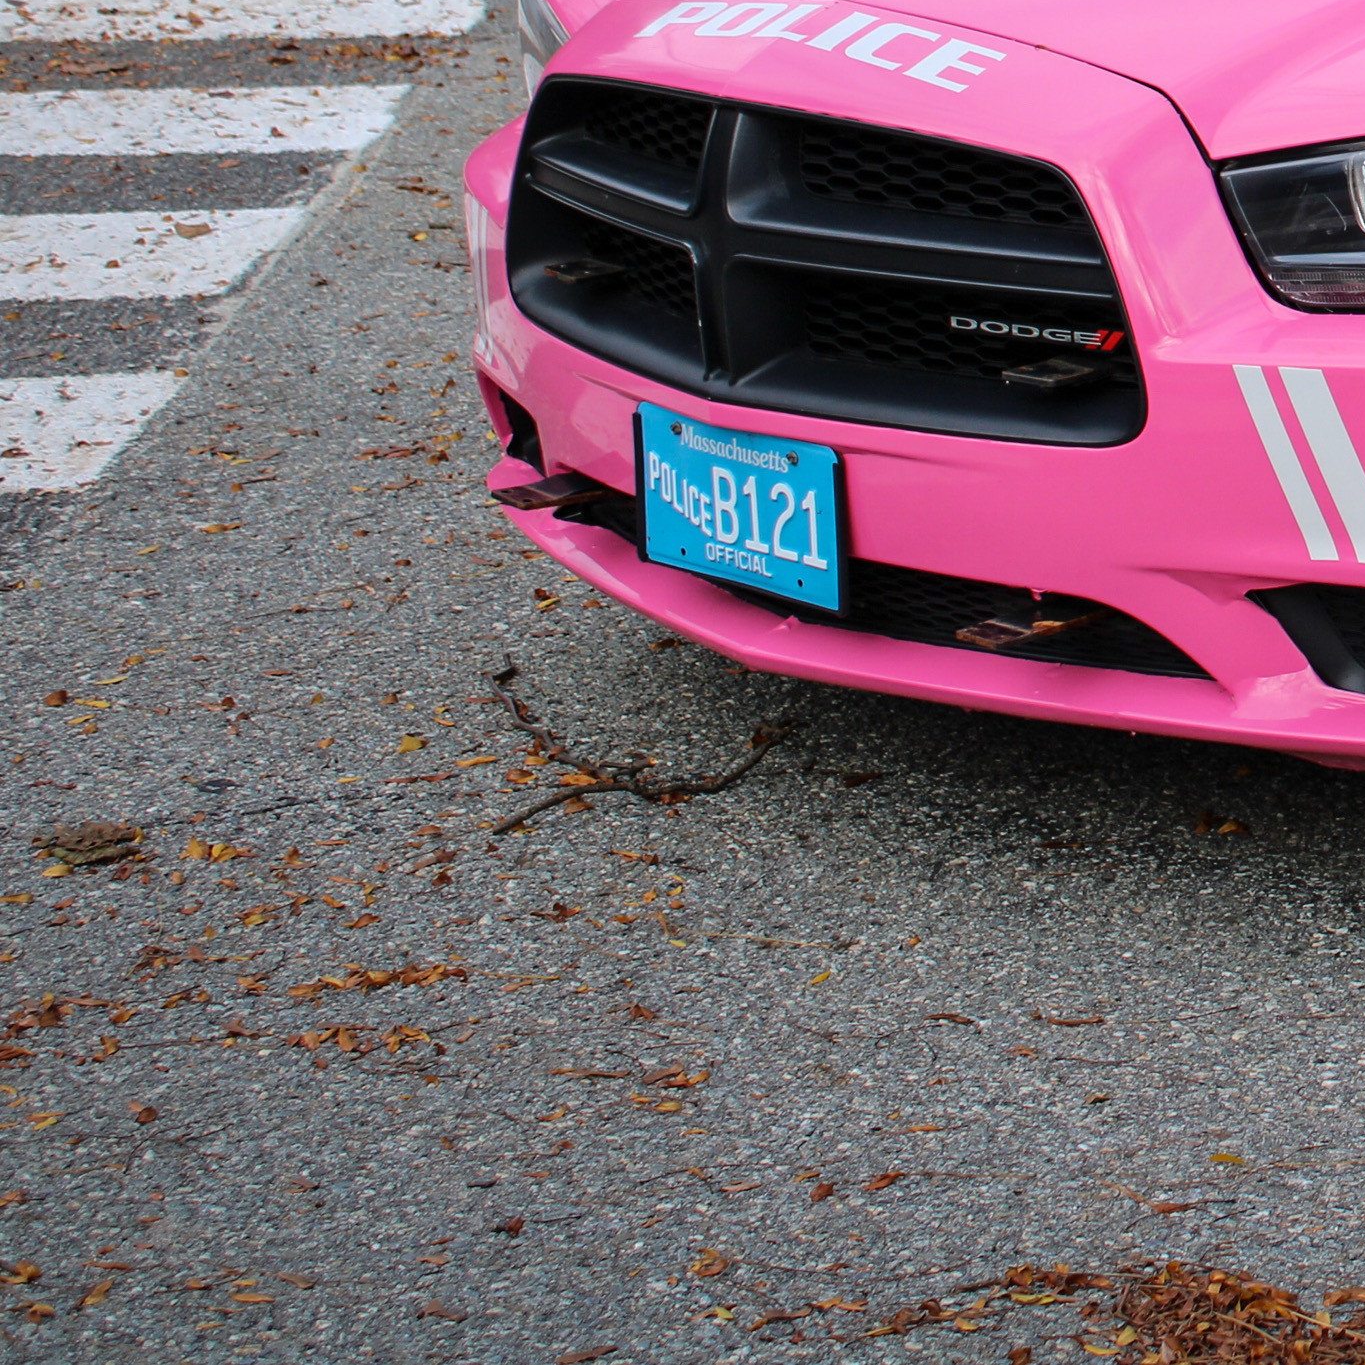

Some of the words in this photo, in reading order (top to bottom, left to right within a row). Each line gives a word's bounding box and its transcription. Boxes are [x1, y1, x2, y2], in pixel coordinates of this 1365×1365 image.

[633, 0, 1005, 93] POLICE
[950, 316, 1102, 346] DODGE
[680, 423, 789, 474] Massachusetts
[650, 451, 713, 538] POLICE
[711, 465, 828, 571] B121
[705, 542, 772, 577] OFFICIAL
